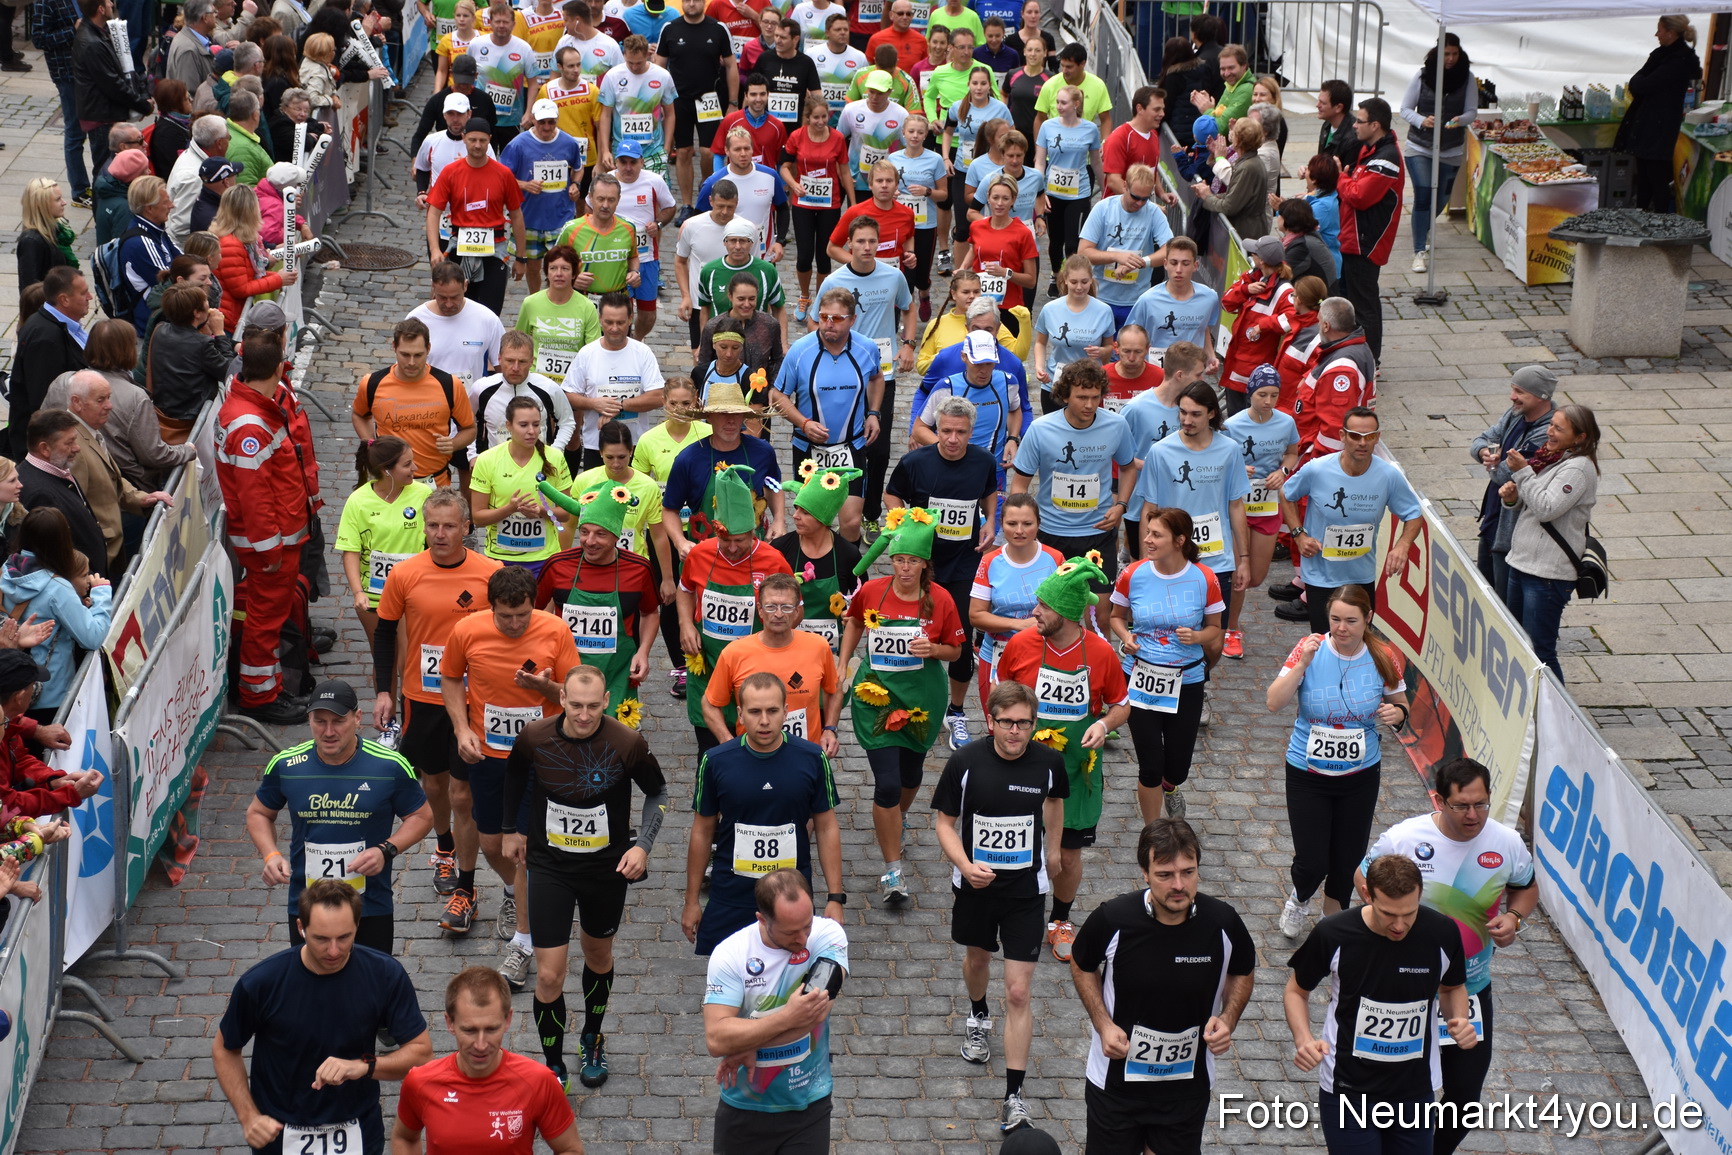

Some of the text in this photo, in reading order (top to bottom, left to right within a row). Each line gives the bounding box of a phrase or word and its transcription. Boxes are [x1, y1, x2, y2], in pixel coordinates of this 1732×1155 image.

[861, 3, 882, 14] 2406
[984, 10, 1014, 18] SYSCAD
[529, 27, 546, 36] MAX
[359, 34, 373, 52] BMW
[776, 81, 793, 89] Berlin
[570, 97, 591, 106] BÖGL
[823, 90, 847, 101] 2345
[702, 99, 719, 111] 324
[771, 100, 796, 111] 2179
[624, 121, 651, 132] 2442
[310, 152, 323, 169] BMW
[541, 168, 562, 181] 314
[1054, 173, 1073, 187] 337
[803, 184, 830, 196] 2452
[287, 208, 296, 231] BMW
[465, 231, 488, 243] 237
[580, 249, 629, 263] BOCK
[981, 280, 1003, 293] 548
[545, 358, 571, 374] 357
[383, 410, 441, 424] Alexander
[392, 420, 438, 432] Schaller
[816, 452, 850, 468] 2022
[1067, 484, 1087, 498] 14
[1368, 493, 1380, 501] HIP
[930, 501, 946, 509] PARTL
[1061, 500, 1089, 509] Matthias
[939, 509, 967, 526] 195
[501, 519, 542, 537] 2006
[939, 526, 961, 535] Stefan
[1192, 526, 1210, 543] 49
[1335, 533, 1365, 547] 143
[510, 539, 532, 547] Carina
[1336, 549, 1358, 557] Stefan
[703, 593, 747, 606] PARTL Neumarkt
[564, 607, 609, 617] PARTL Neumarkt
[706, 602, 749, 624] 2084
[569, 616, 613, 635] 2140
[717, 625, 734, 635] Reto
[870, 629, 887, 637] PARTL
[574, 636, 606, 649] Wolfgang
[884, 657, 909, 666] Brigitte
[1136, 662, 1175, 677] PARTL Neumarkt
[1039, 673, 1056, 682] PARTL
[1135, 671, 1175, 695] 3051
[1040, 682, 1086, 704] 2423
[486, 708, 504, 717] PARTL
[1044, 706, 1080, 715] Johannes
[1311, 729, 1328, 738] PARTL
[1312, 738, 1360, 760] 2589
[285, 753, 309, 767] zillo
[1325, 762, 1344, 771] Jana
[1014, 785, 1042, 794] PFLEIDERER
[308, 792, 360, 811] Blond!
[549, 805, 568, 815] PARTL
[558, 817, 597, 836] 124
[974, 819, 994, 828] PARTL
[736, 828, 757, 837] PARTL
[564, 837, 591, 847] Stefan
[979, 829, 1028, 850] 2281
[306, 847, 356, 856] PARTL Neumarkt
[753, 839, 780, 859] 88
[987, 853, 1019, 863] Rüdiger
[1479, 855, 1501, 866] Hervis
[752, 862, 779, 873] Pascal
[1180, 956, 1211, 964] PFLEIDERER
[1403, 966, 1430, 974] PFLEIDERER
[744, 977, 767, 986] PARTL
[1361, 1003, 1418, 1015] PARTL Neumarkt
[1363, 1015, 1422, 1040] 2270
[1133, 1029, 1191, 1044] PARTL Neumarkt
[756, 1045, 801, 1060] Benjamin
[1135, 1041, 1193, 1063] 2135
[1371, 1042, 1410, 1054] Andreas
[787, 1066, 805, 1078] 16.
[1147, 1065, 1174, 1075] Bernd
[286, 1121, 349, 1133] PARTL Neumarkt
[299, 1128, 348, 1155] 219
